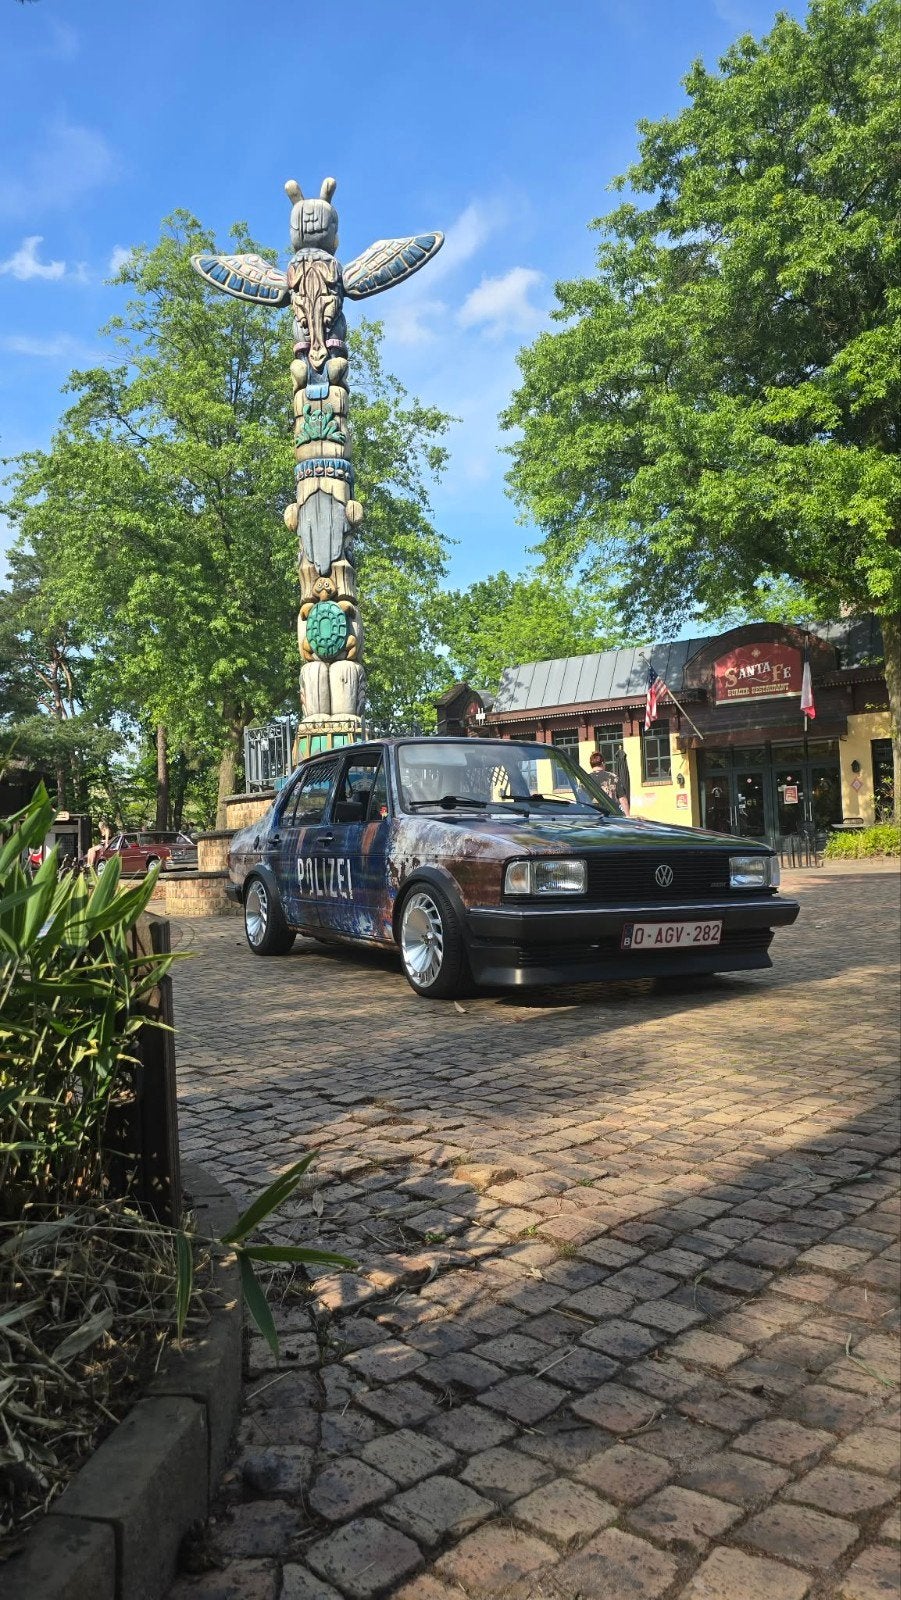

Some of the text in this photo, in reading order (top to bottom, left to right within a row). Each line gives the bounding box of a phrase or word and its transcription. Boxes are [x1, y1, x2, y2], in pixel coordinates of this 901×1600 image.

[724, 661, 791, 688] SANTA FE
[727, 682, 790, 697] BURGER RESTAURANT
[297, 857, 354, 900] POLIZEI
